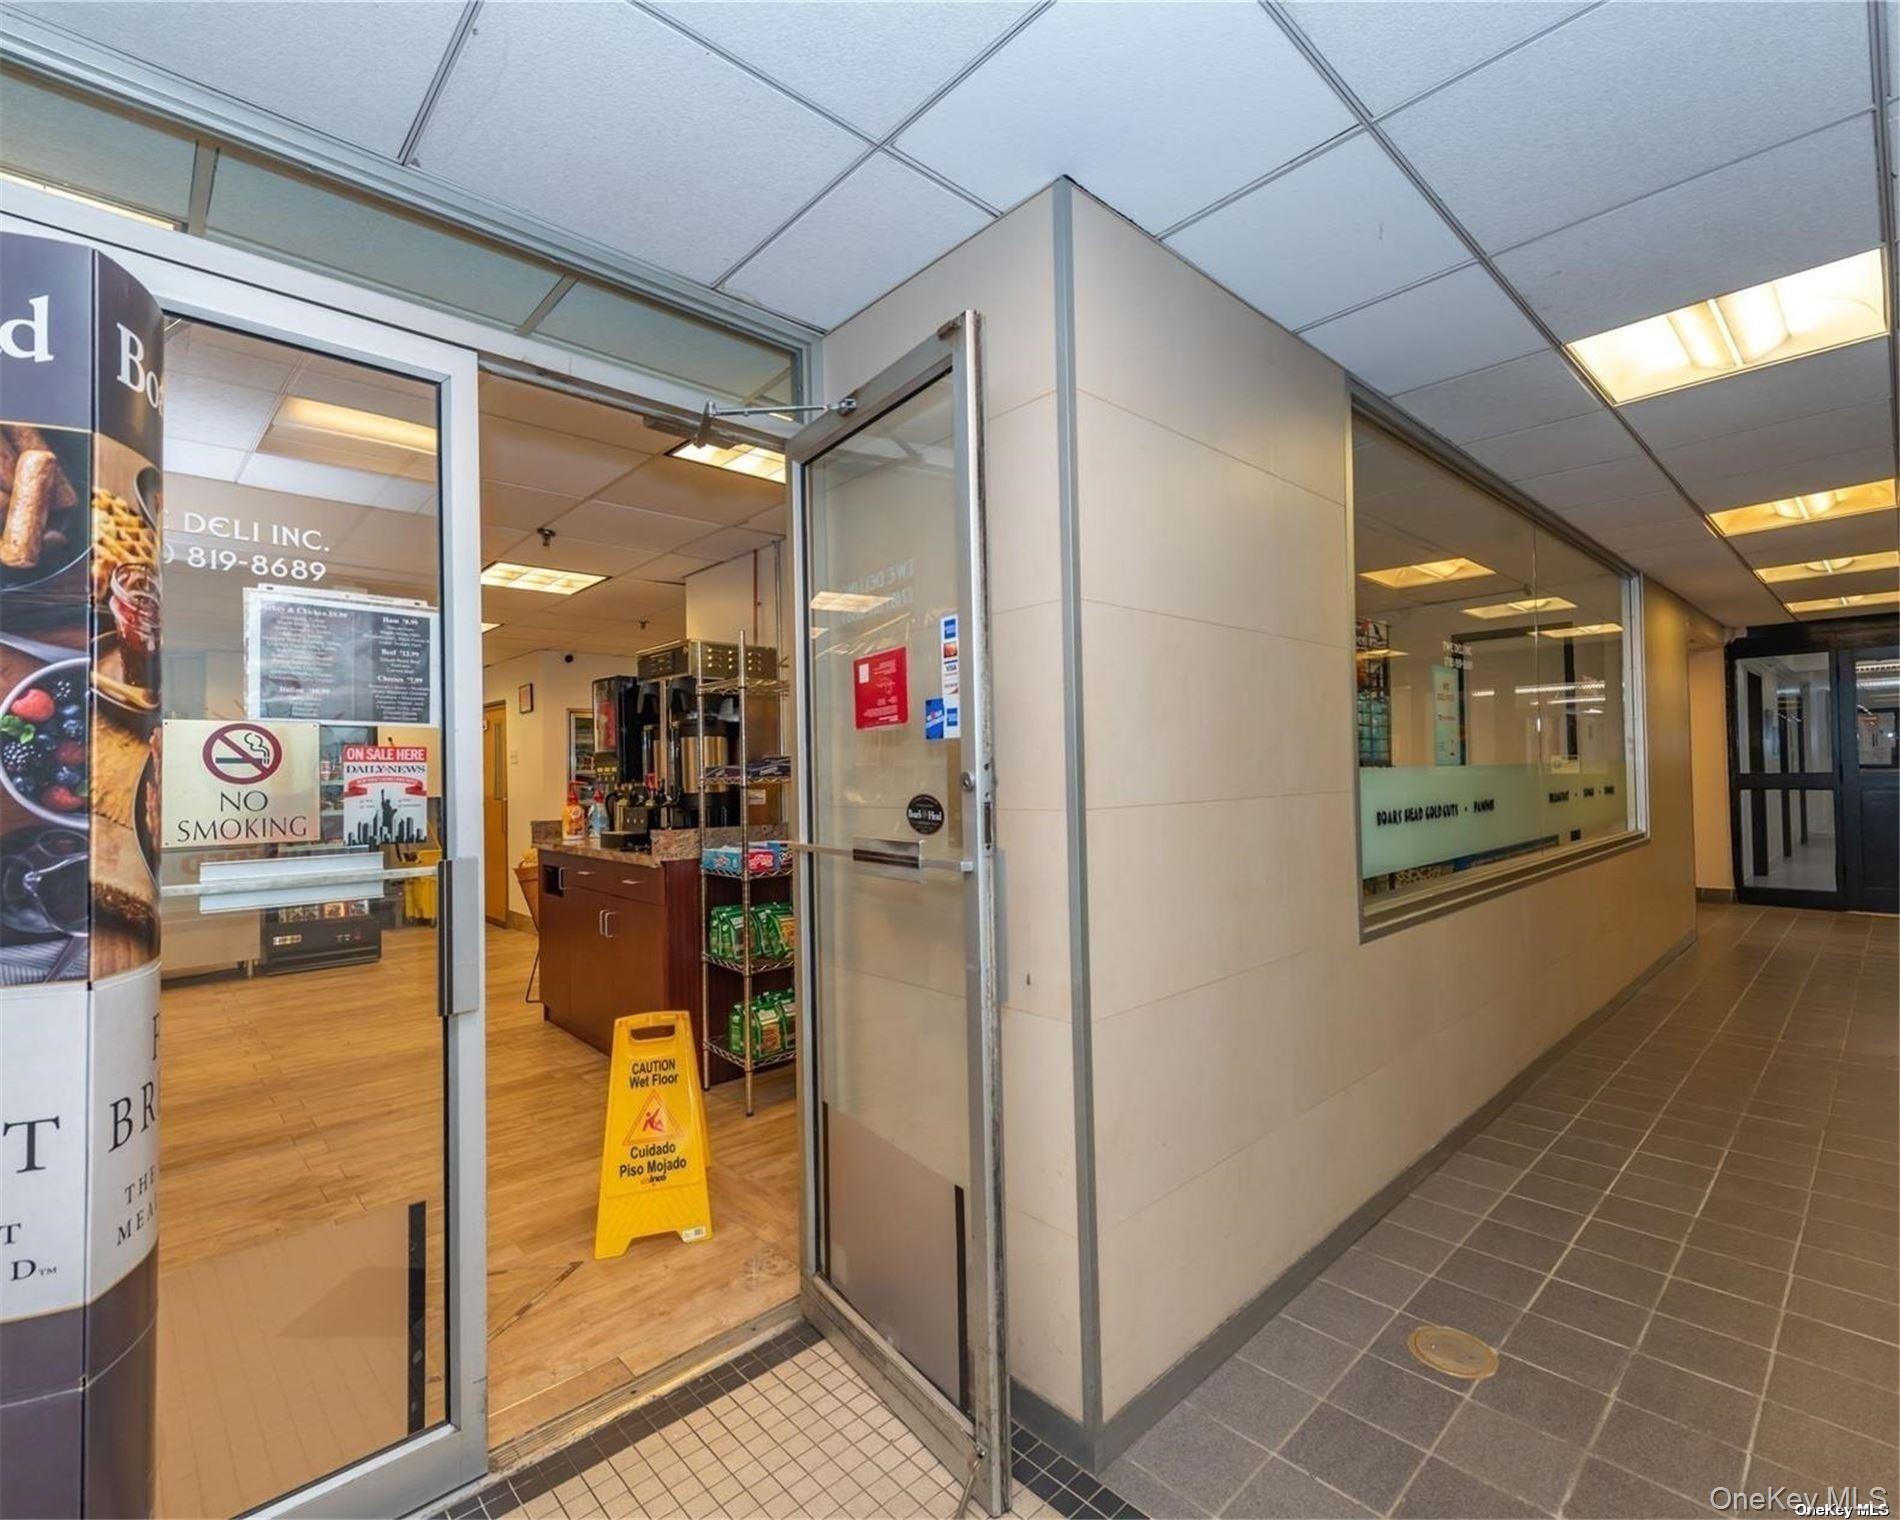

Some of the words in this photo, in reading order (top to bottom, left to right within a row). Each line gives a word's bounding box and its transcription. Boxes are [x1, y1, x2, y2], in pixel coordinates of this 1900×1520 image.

[0, 295, 54, 363] d
[117, 322, 163, 415] Bo
[184, 511, 260, 542] DELI
[271, 524, 330, 552] INC.
[187, 546, 327, 581] 819-8689
[346, 747, 365, 761] ON
[366, 747, 396, 761] SALE
[396, 748, 426, 761] HERE
[346, 765, 385, 774] DAILY
[388, 765, 426, 774] NEWS
[220, 790, 268, 812] NO
[1403, 806, 1423, 823] HEAD
[177, 815, 307, 843] SMOKING
[631, 1058, 676, 1075] CAUTION
[629, 1075, 650, 1089] Wet
[652, 1073, 679, 1086] Floor
[3, 1116, 60, 1173] T
[630, 1141, 676, 1159] Cuidado
[619, 1164, 644, 1178] Piso
[647, 1156, 687, 1175] Mojado
